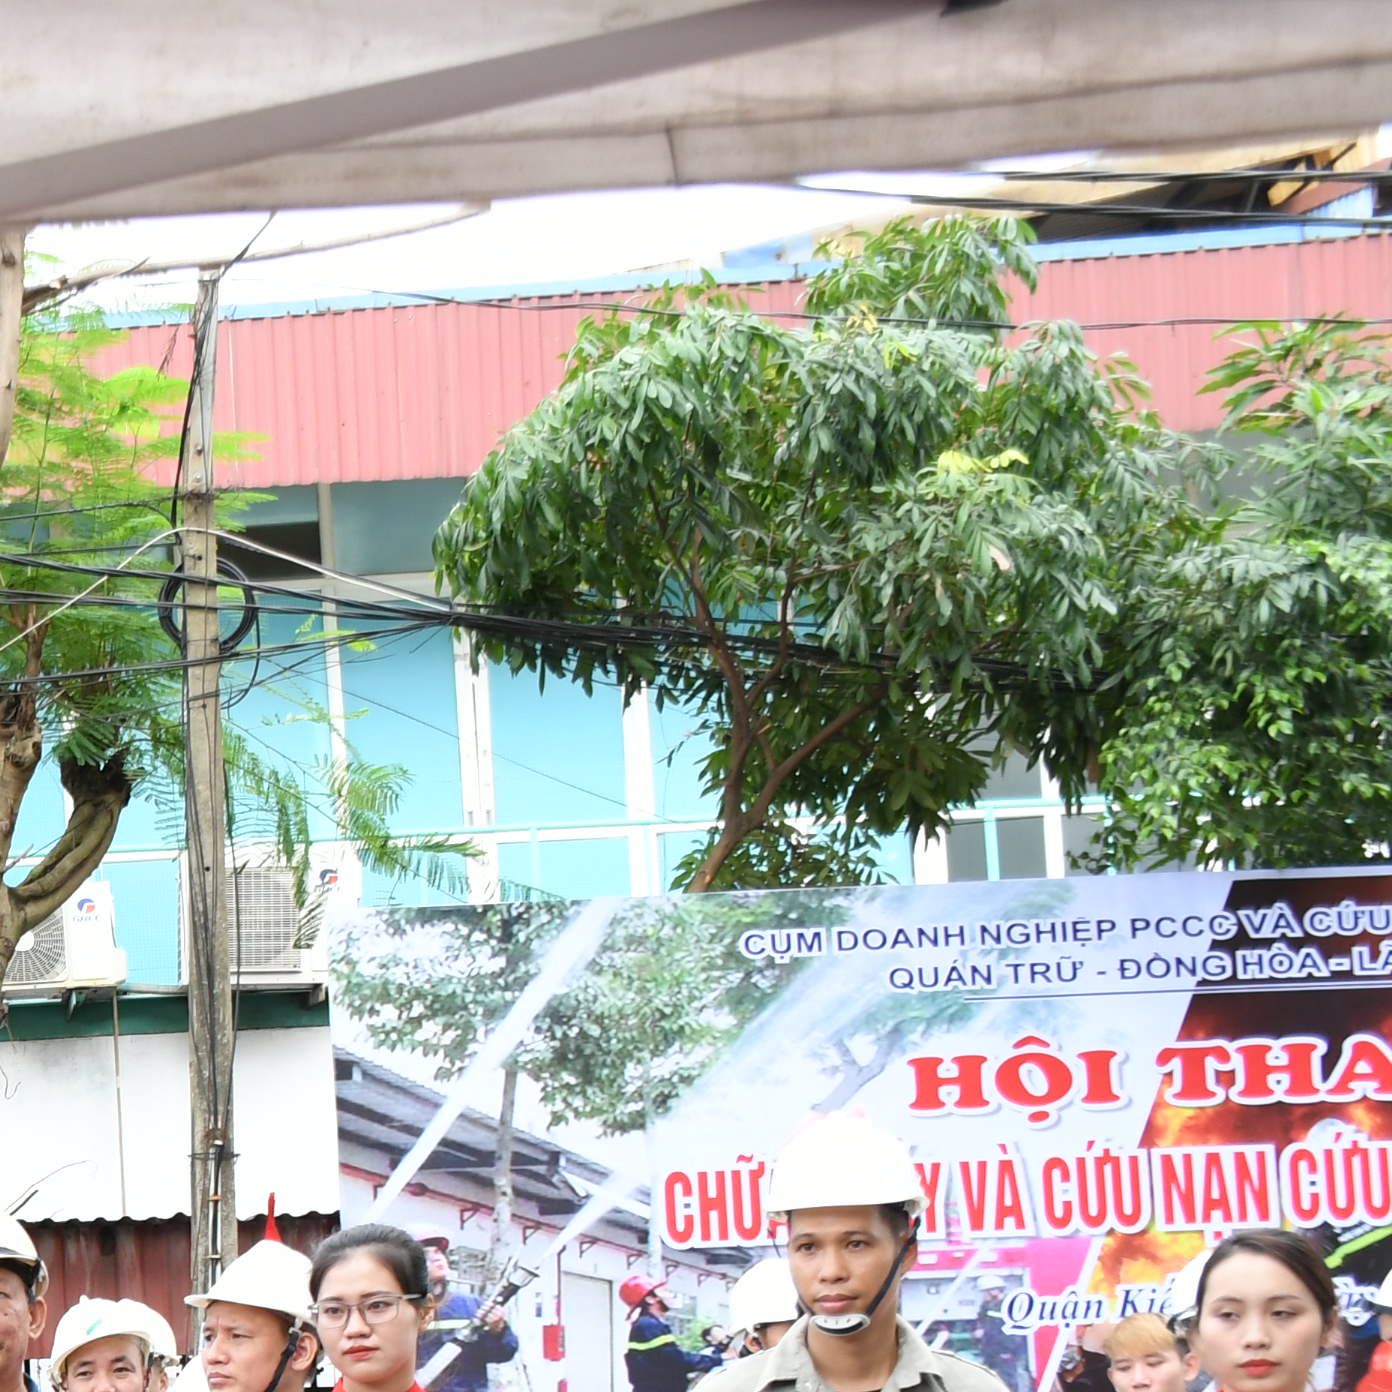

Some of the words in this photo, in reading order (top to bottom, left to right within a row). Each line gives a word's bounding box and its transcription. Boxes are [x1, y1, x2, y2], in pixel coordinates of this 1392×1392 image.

[744, 931, 823, 960] CỤM
[836, 925, 966, 952] DOANH
[980, 917, 1117, 948] NGHIỆP
[1130, 912, 1234, 939] PCCC
[1240, 901, 1298, 935] VÀ
[1308, 901, 1391, 932] CỨU
[889, 960, 992, 990] QUÁN
[1005, 956, 1083, 984] TRỮ
[1117, 953, 1228, 980] ĐỒNG
[1235, 944, 1323, 975] HÒA
[907, 1036, 1121, 1123] HỘI
[959, 1143, 1026, 1232] VÀ
[1042, 1140, 1143, 1230] CỨU
[1160, 1150, 1271, 1240] NẠN
[1289, 1131, 1391, 1222] CỨU
[1007, 1289, 1104, 1328] Quận
